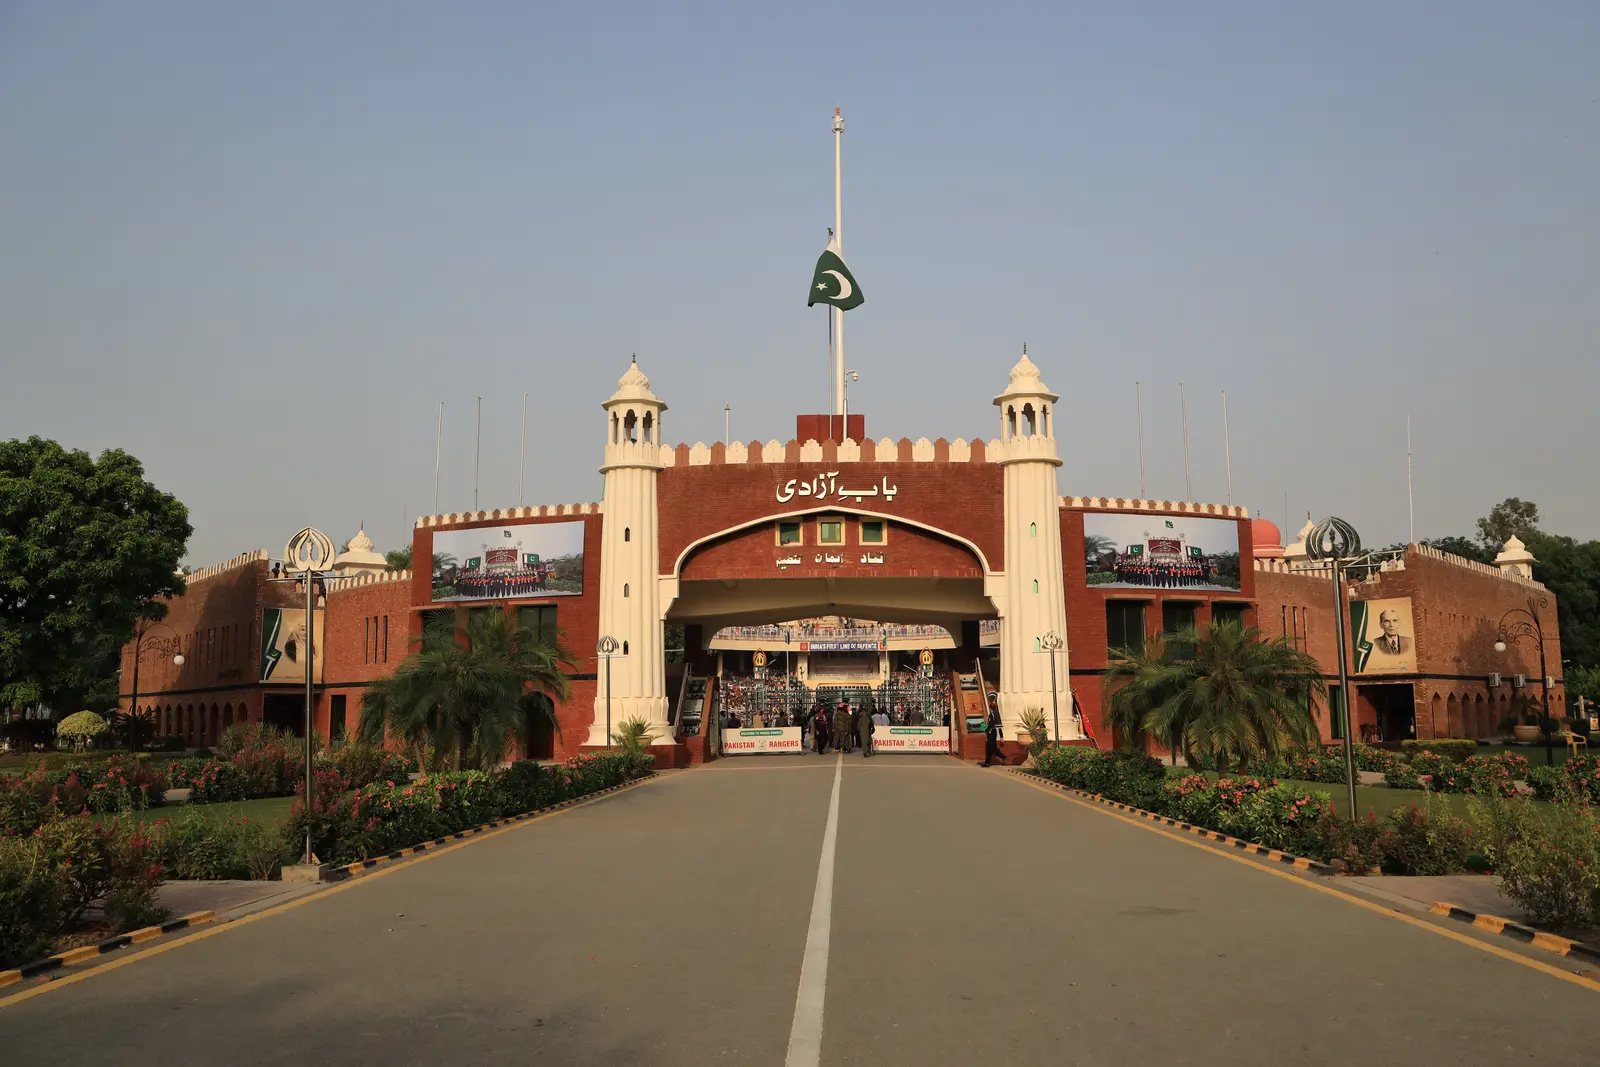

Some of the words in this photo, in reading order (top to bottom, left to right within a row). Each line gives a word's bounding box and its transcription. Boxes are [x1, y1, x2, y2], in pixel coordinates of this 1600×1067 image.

[776, 470, 840, 503] آزادی
[724, 741, 755, 749] PAKISTAN
[768, 740, 799, 748] RANGERS
[874, 739, 905, 747] PAKISTAN
[918, 739, 949, 747] RANGERS
